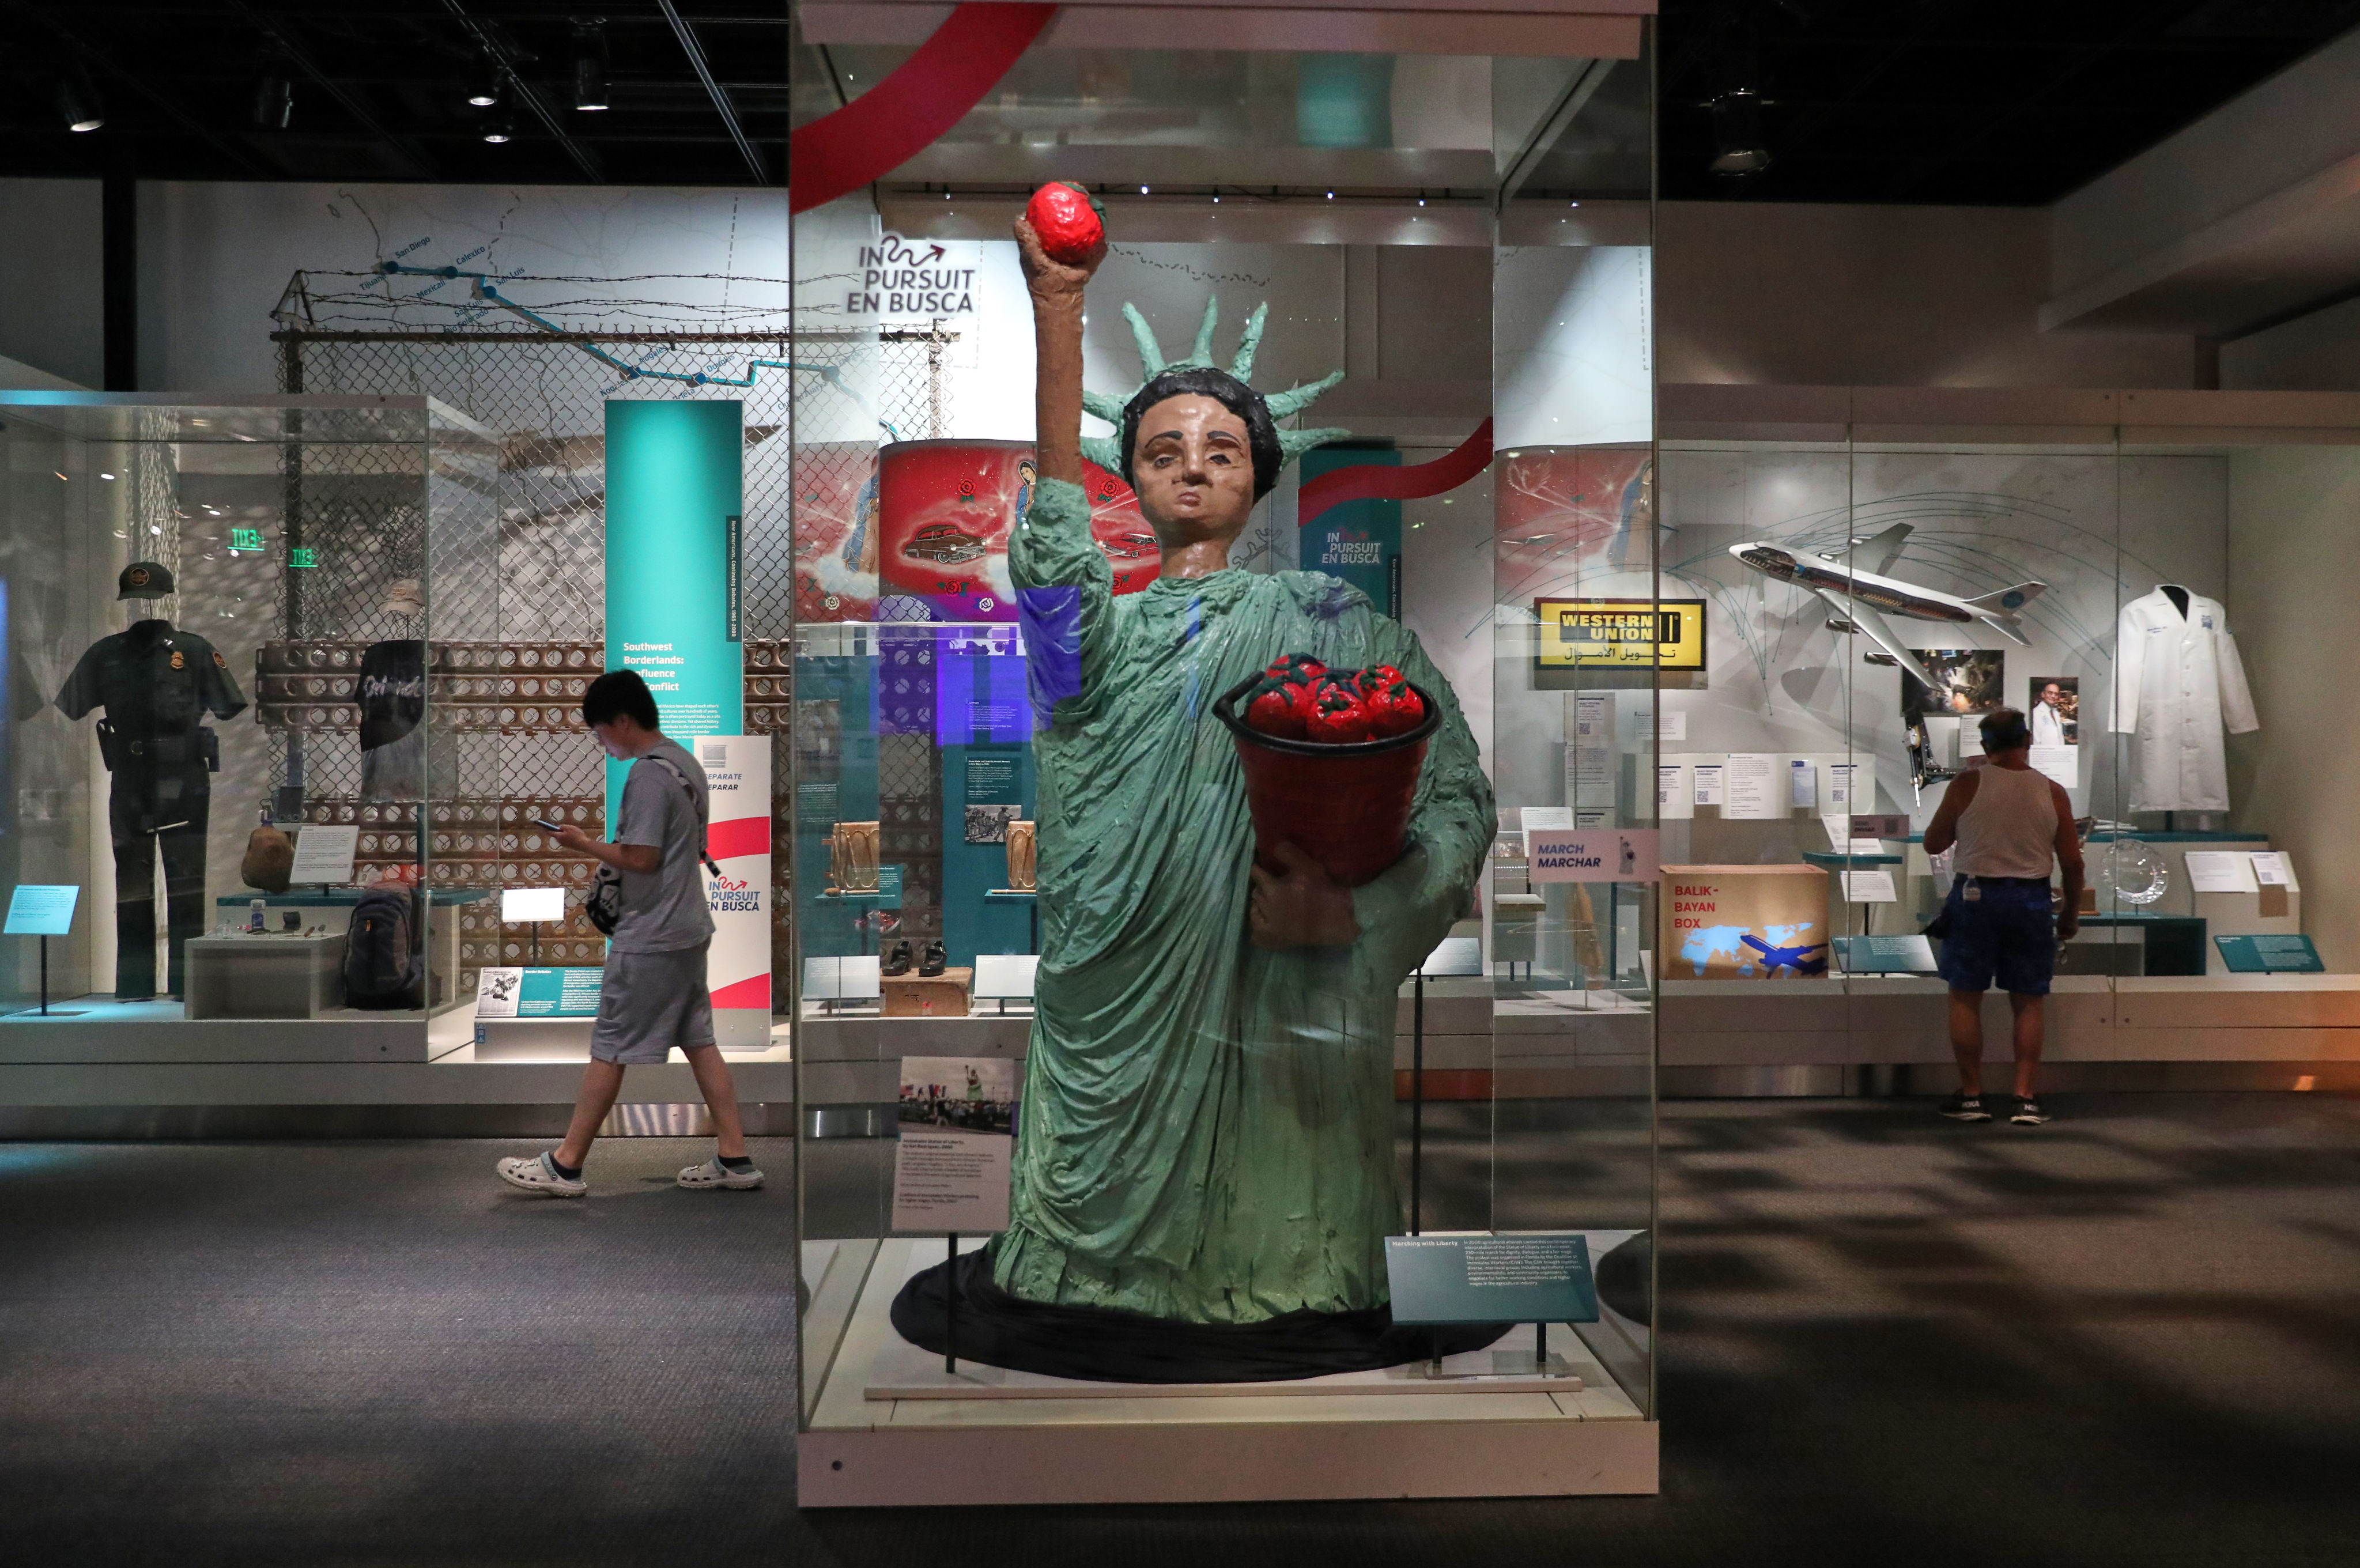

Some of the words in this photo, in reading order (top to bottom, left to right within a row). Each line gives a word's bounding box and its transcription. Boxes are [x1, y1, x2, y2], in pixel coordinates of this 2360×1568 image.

[395, 247, 410, 259] San
[409, 236, 431, 251] Diego
[456, 245, 485, 266] Calexico
[859, 247, 885, 267] IN
[496, 274, 510, 286] San
[510, 266, 525, 278] Luis
[864, 270, 975, 290] PURSUIT
[359, 274, 387, 292] Tijuana
[417, 280, 446, 298] Mexicali
[847, 292, 880, 313] EN
[889, 292, 974, 313] BUSCA
[639, 346, 670, 364] Nogales
[707, 356, 735, 373] Douglas
[600, 379, 629, 397] Nogales
[1327, 532, 1340, 542] IN
[1330, 543, 1380, 553] PURSUIT
[1321, 553, 1338, 564] EN
[1341, 553, 1380, 564] BUSCA
[1561, 614, 1653, 626] WESTERN
[1591, 628, 1653, 640] UNION
[624, 643, 673, 651] Southwest
[624, 656, 685, 664] Borderlands:
[635, 670, 676, 678] nfluence
[647, 682, 679, 691] onflict
[1538, 844, 1584, 854] MARCH
[1538, 857, 1601, 868] MARCHAR
[709, 881, 721, 891] IN
[711, 891, 760, 901] PURSUIT
[722, 901, 760, 911] BUSCA
[1675, 902, 1715, 912] BAYAN
[1675, 919, 1701, 928] BOX
